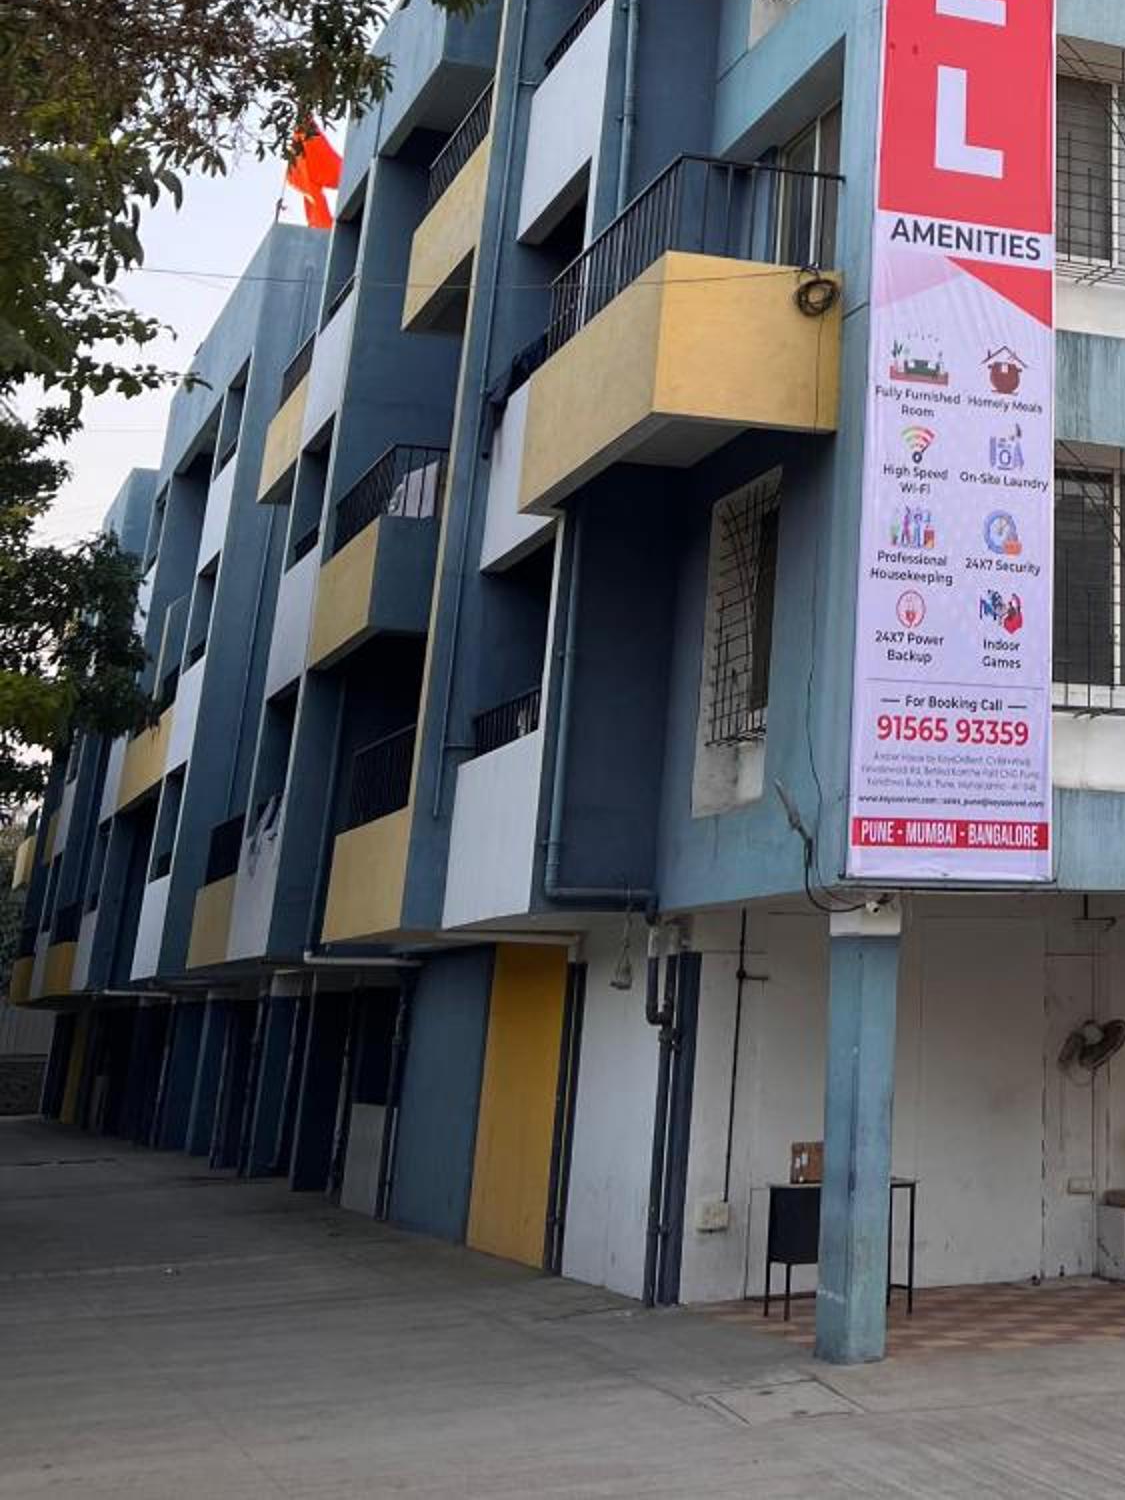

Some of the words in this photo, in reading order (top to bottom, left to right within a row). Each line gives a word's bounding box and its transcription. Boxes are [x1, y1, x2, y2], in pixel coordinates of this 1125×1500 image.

[891, 218, 1041, 260] AMENITIES
[875, 385, 902, 399] Fully
[905, 389, 961, 404] Furnished
[901, 404, 935, 418] Room
[968, 396, 1010, 412] Homely
[1012, 401, 1043, 414] Meals
[883, 464, 910, 479] High
[912, 466, 948, 480] Speed
[960, 472, 1001, 487] On-Site
[1003, 476, 1049, 492] Laundry
[877, 550, 948, 566] Professional
[995, 559, 1041, 576] Security
[870, 568, 953, 586] Housekeeping
[907, 633, 944, 646] Power
[983, 638, 1021, 651] Indoor
[887, 648, 932, 663] Backup
[982, 655, 1021, 669] Games
[905, 695, 925, 707] For
[929, 696, 977, 713] Booking
[981, 699, 1003, 711] Call
[877, 715, 948, 742] 91565
[956, 719, 1029, 745] 93359
[861, 820, 895, 842] PUNE
[905, 822, 956, 844] MUMBAI
[968, 823, 1039, 847] BANGALORE
